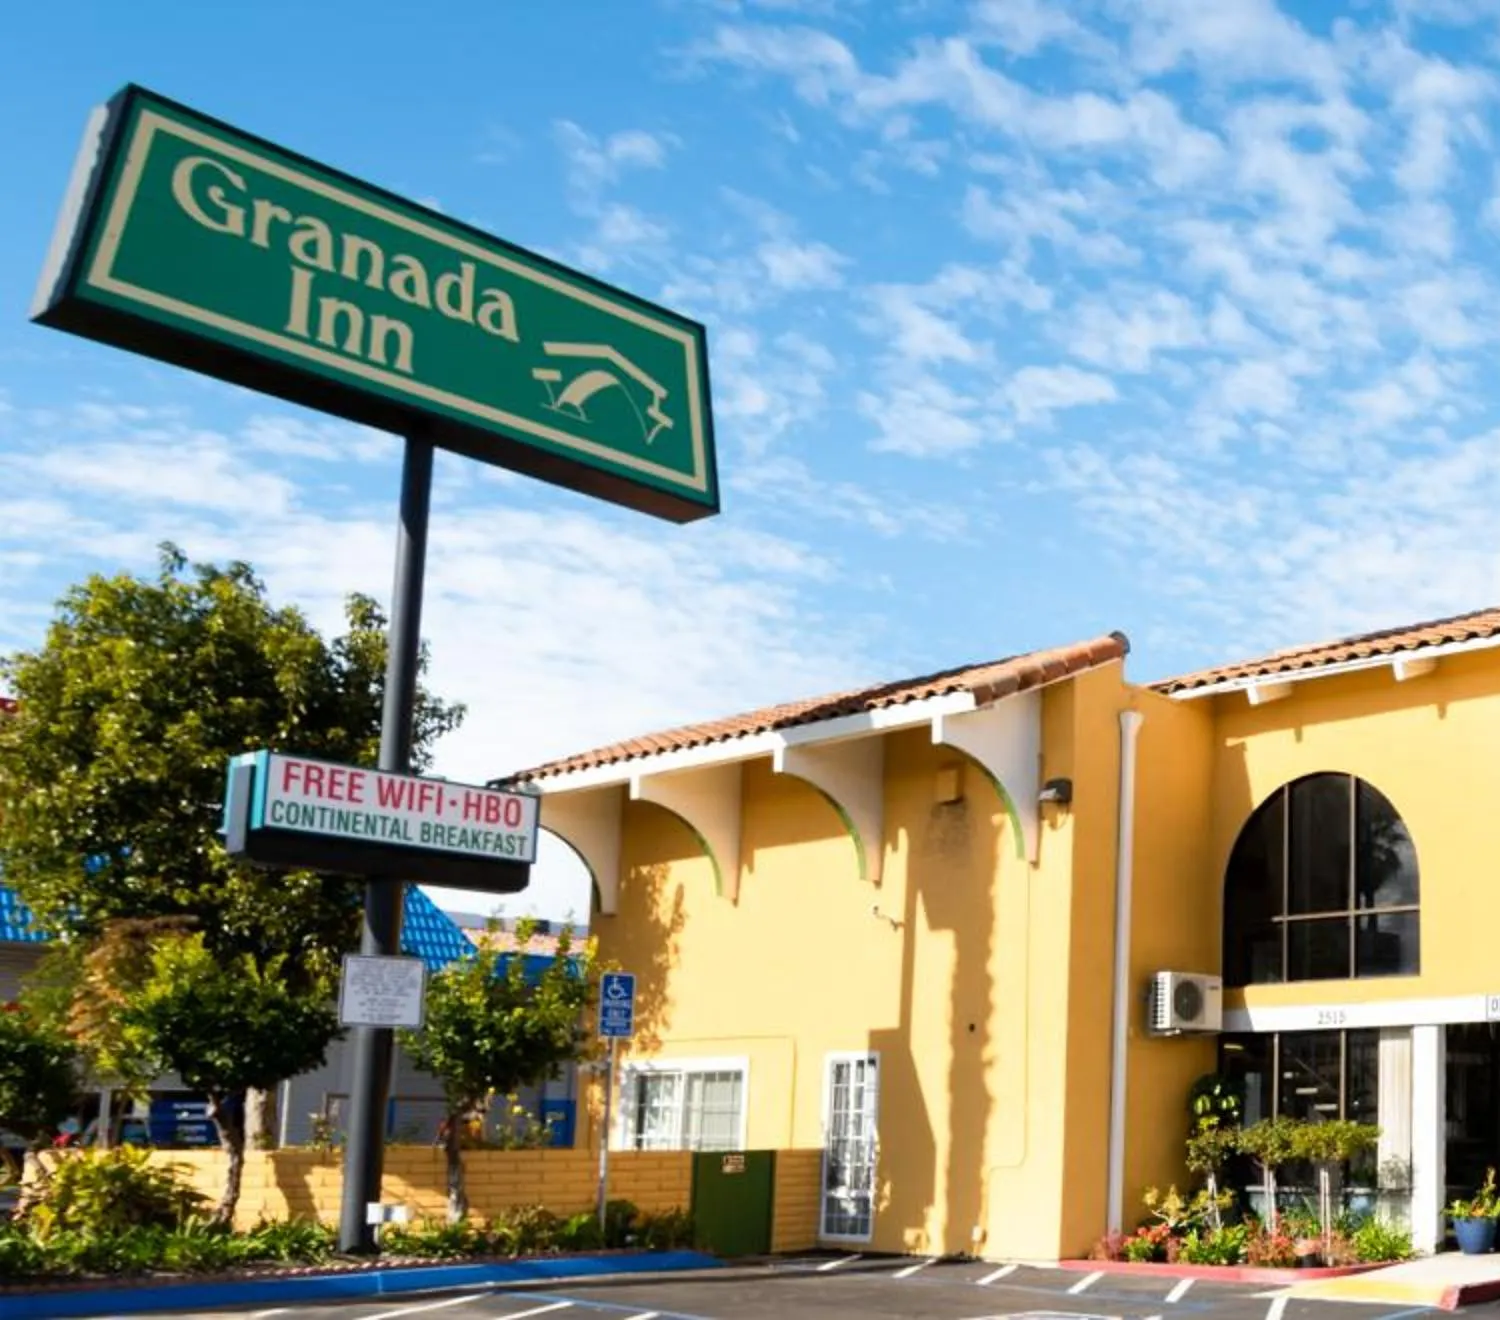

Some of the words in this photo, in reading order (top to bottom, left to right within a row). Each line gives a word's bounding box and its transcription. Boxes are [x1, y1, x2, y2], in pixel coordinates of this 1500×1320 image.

[172, 156, 520, 341] Granada
[284, 265, 414, 373] Inn
[282, 761, 365, 804] FREE
[271, 800, 412, 841] CONTINENTAL
[419, 822, 528, 857] BREAKFAST
